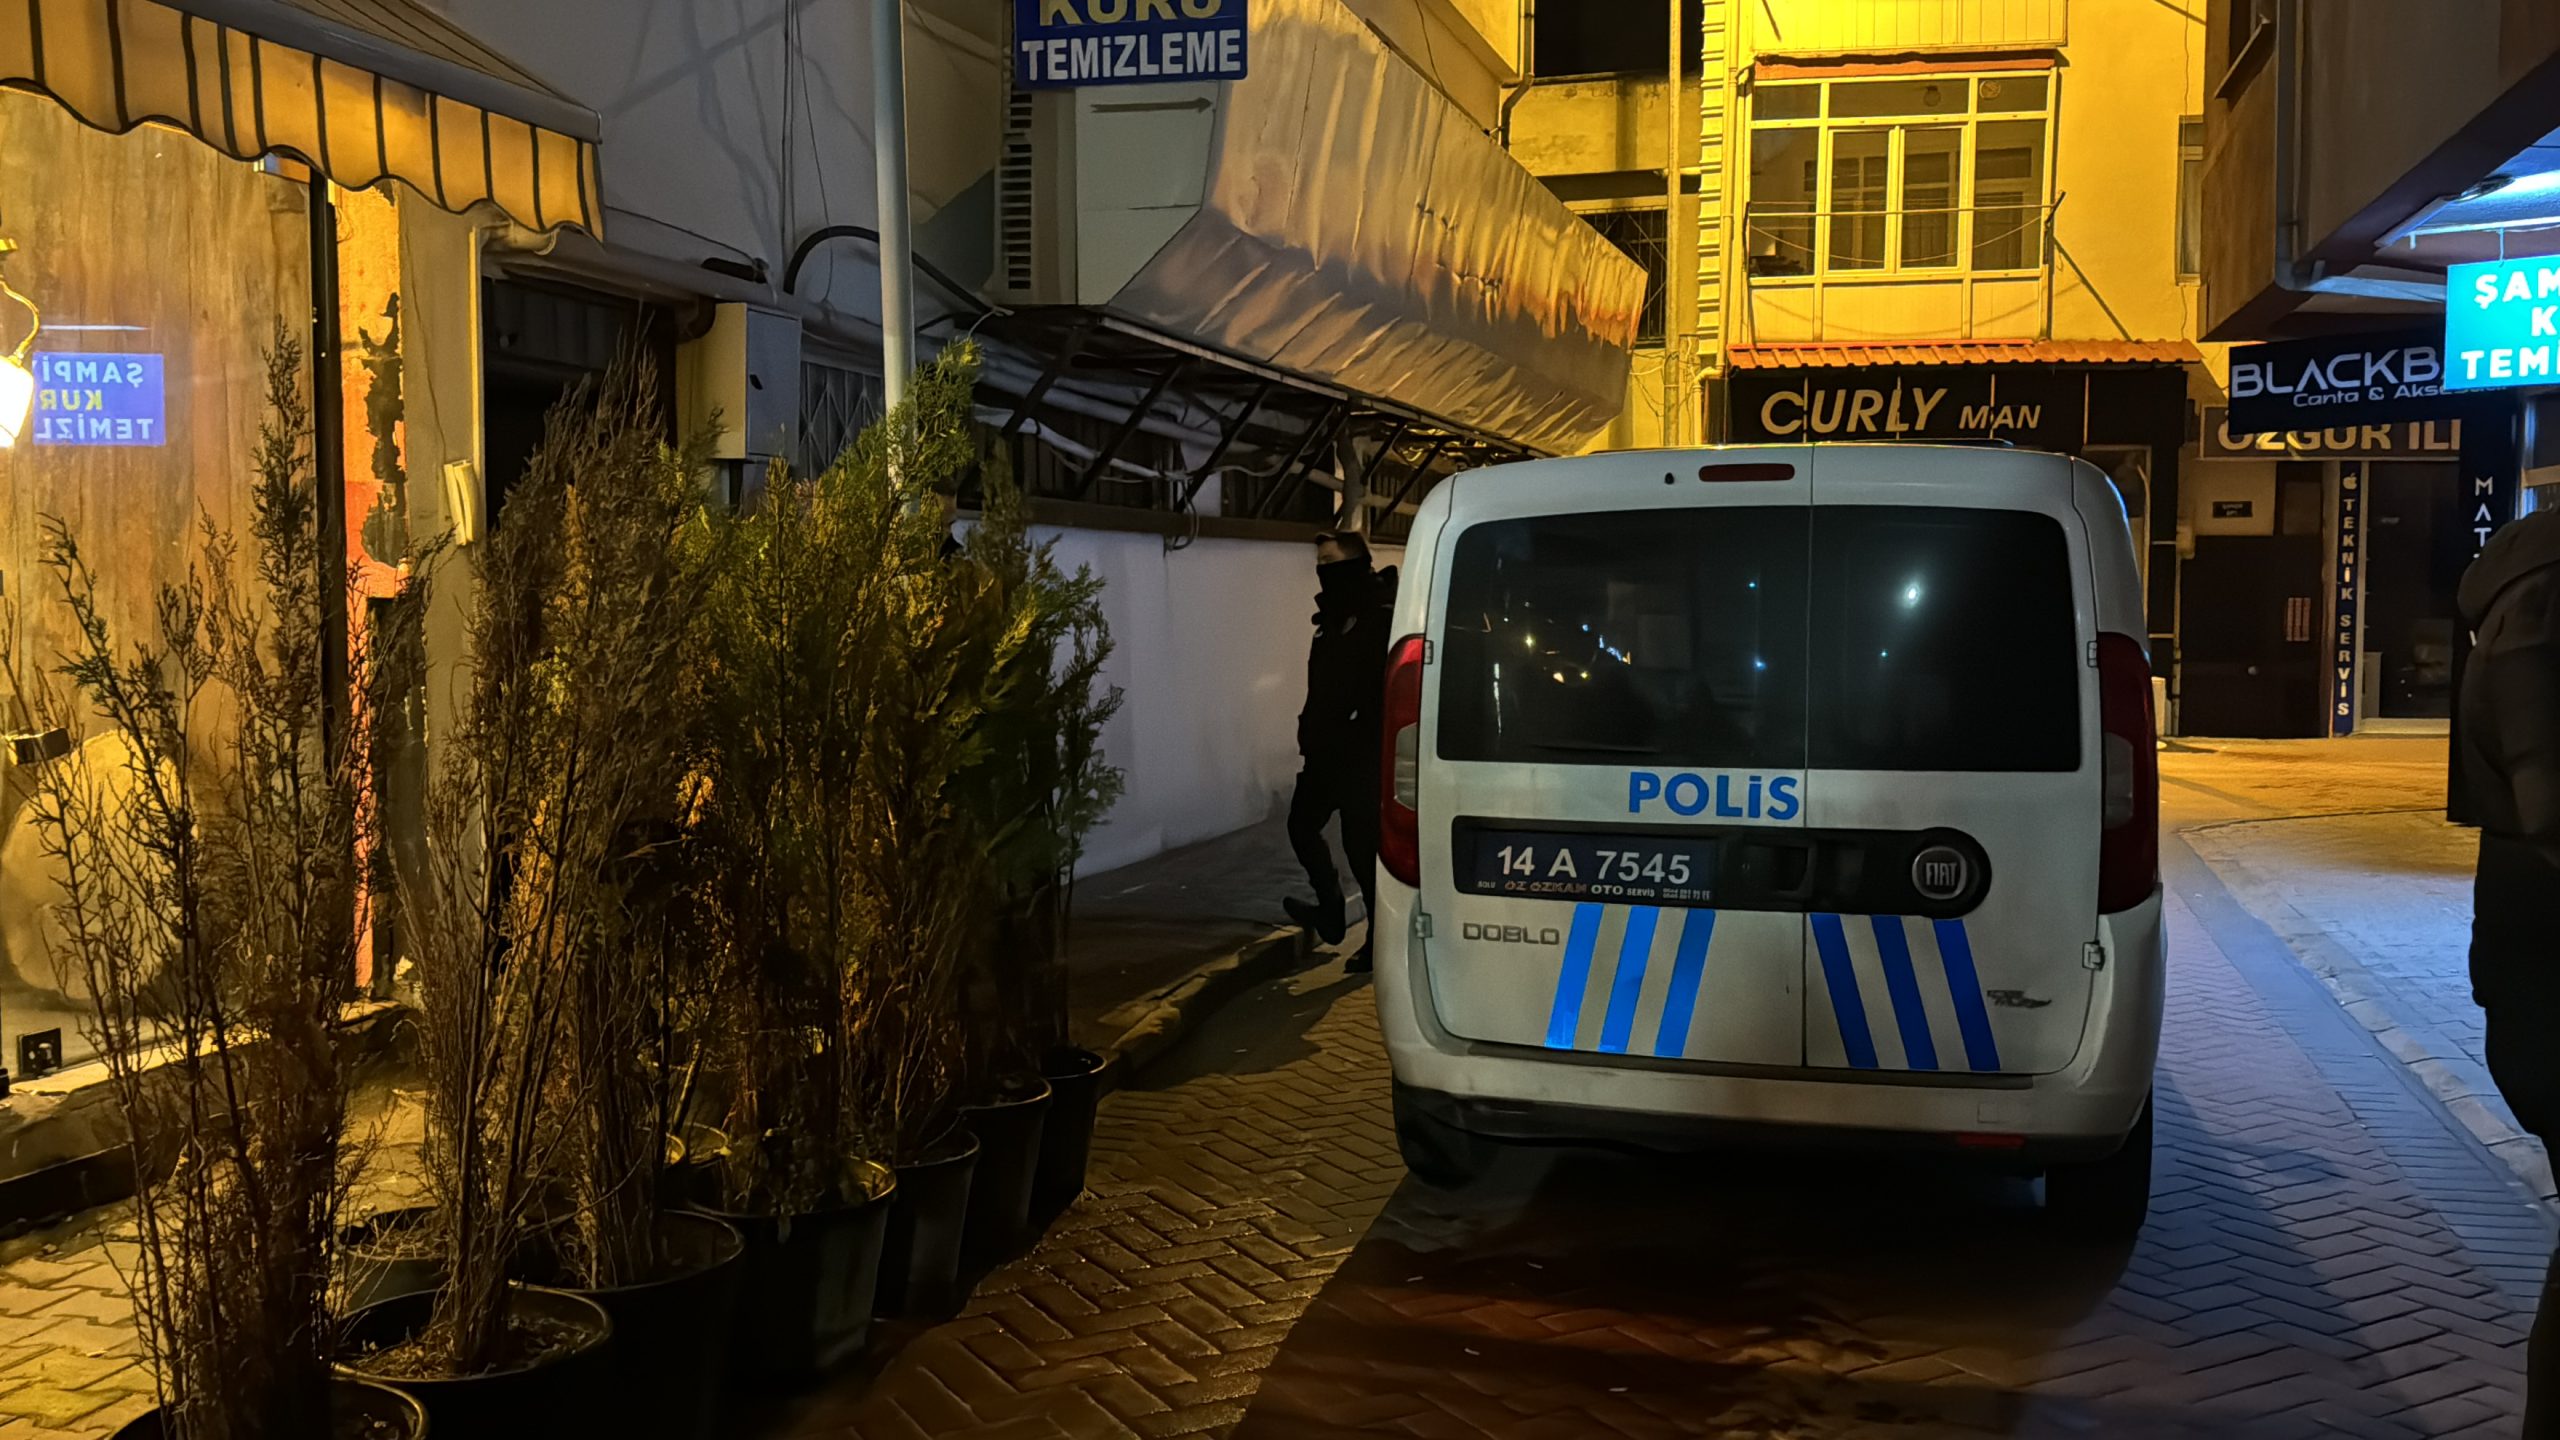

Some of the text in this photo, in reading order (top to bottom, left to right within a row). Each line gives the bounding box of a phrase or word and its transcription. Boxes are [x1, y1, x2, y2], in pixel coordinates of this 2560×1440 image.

[2531, 305, 2558, 337] K
[2231, 346, 2444, 398] BLACKB
[2368, 386, 2385, 401] &
[1760, 387, 2041, 435] CURLY MAN
[1498, 846, 1690, 884] 14 A 7545
[1925, 862, 1957, 886] FIAT
[1591, 885, 1624, 895] OTO
[1463, 922, 1560, 945] DOBLO
